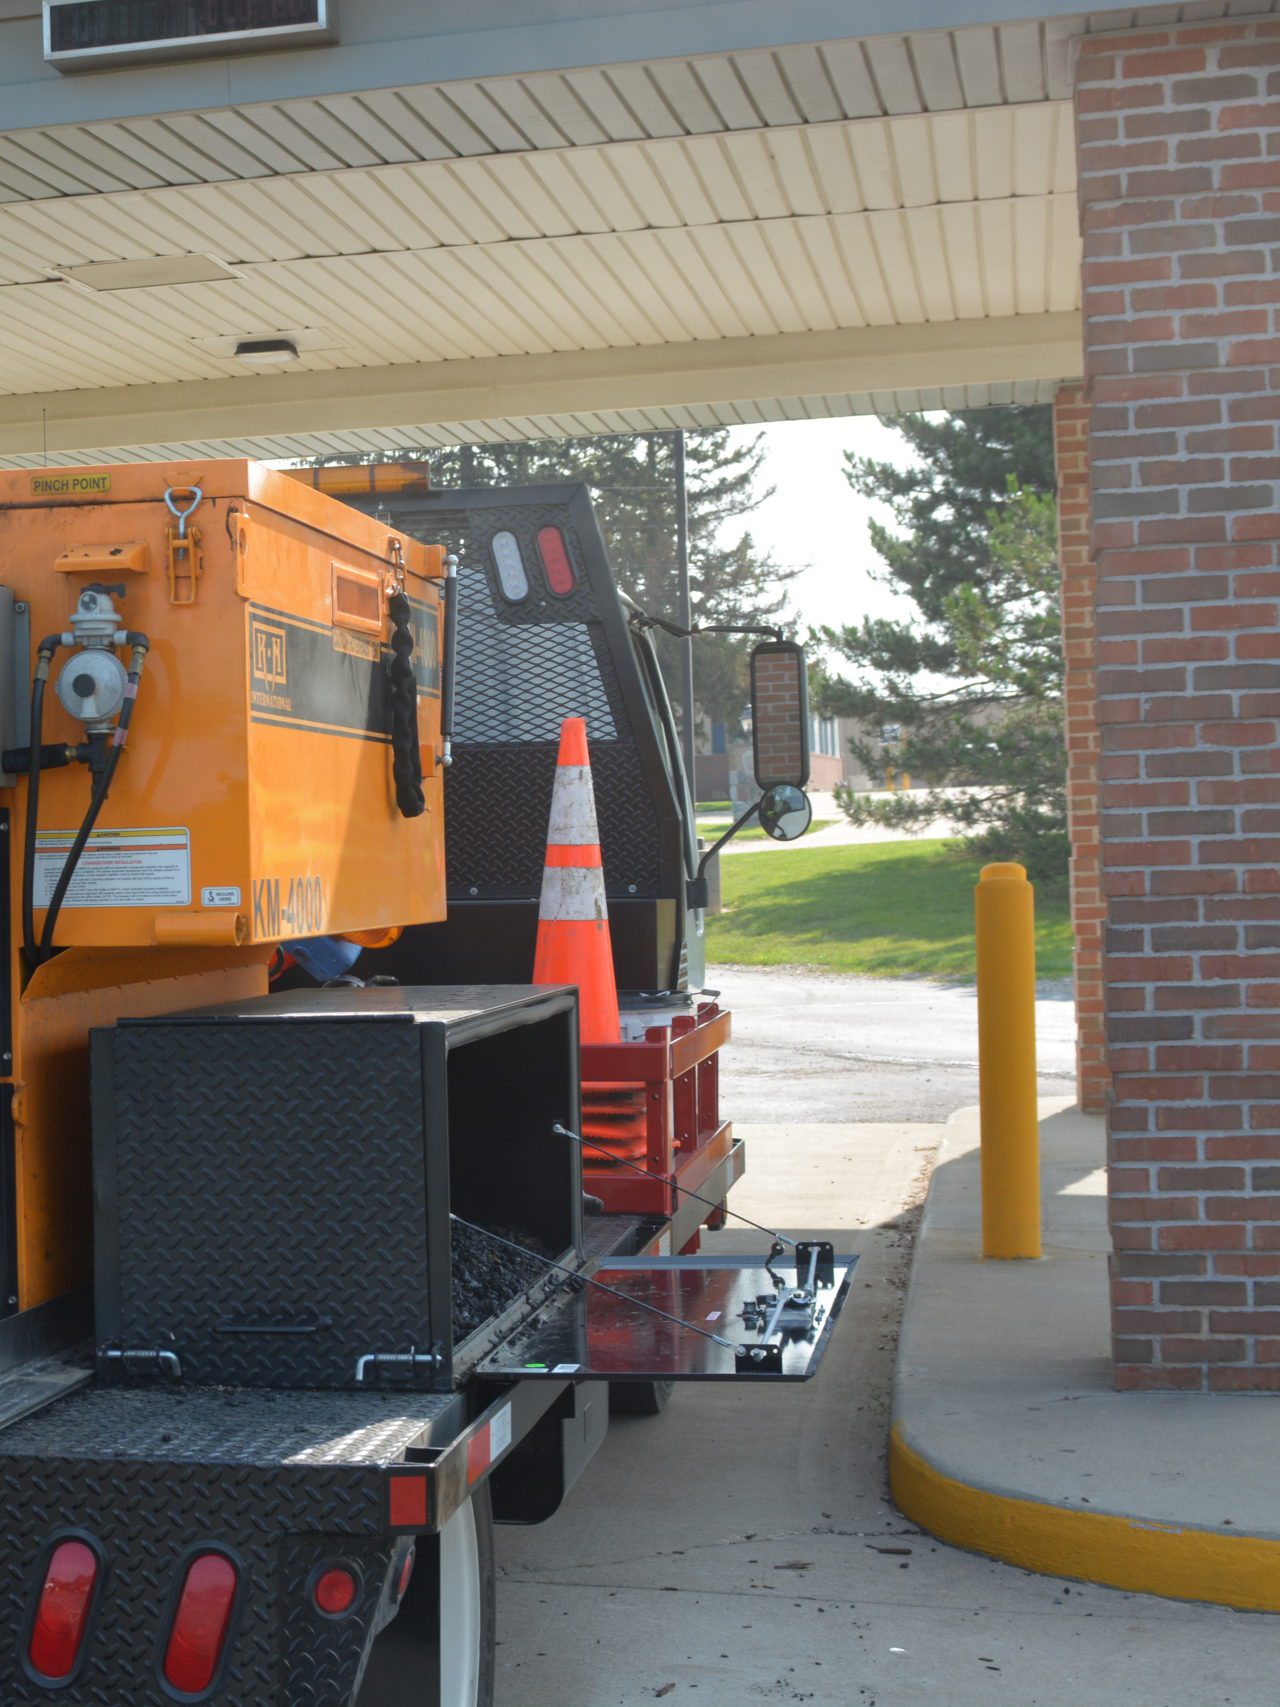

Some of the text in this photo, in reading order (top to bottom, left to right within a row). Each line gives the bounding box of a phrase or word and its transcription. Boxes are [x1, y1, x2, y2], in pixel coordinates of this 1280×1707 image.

[34, 477, 107, 492] PINCH POINT
[253, 876, 322, 939] KM-4000
